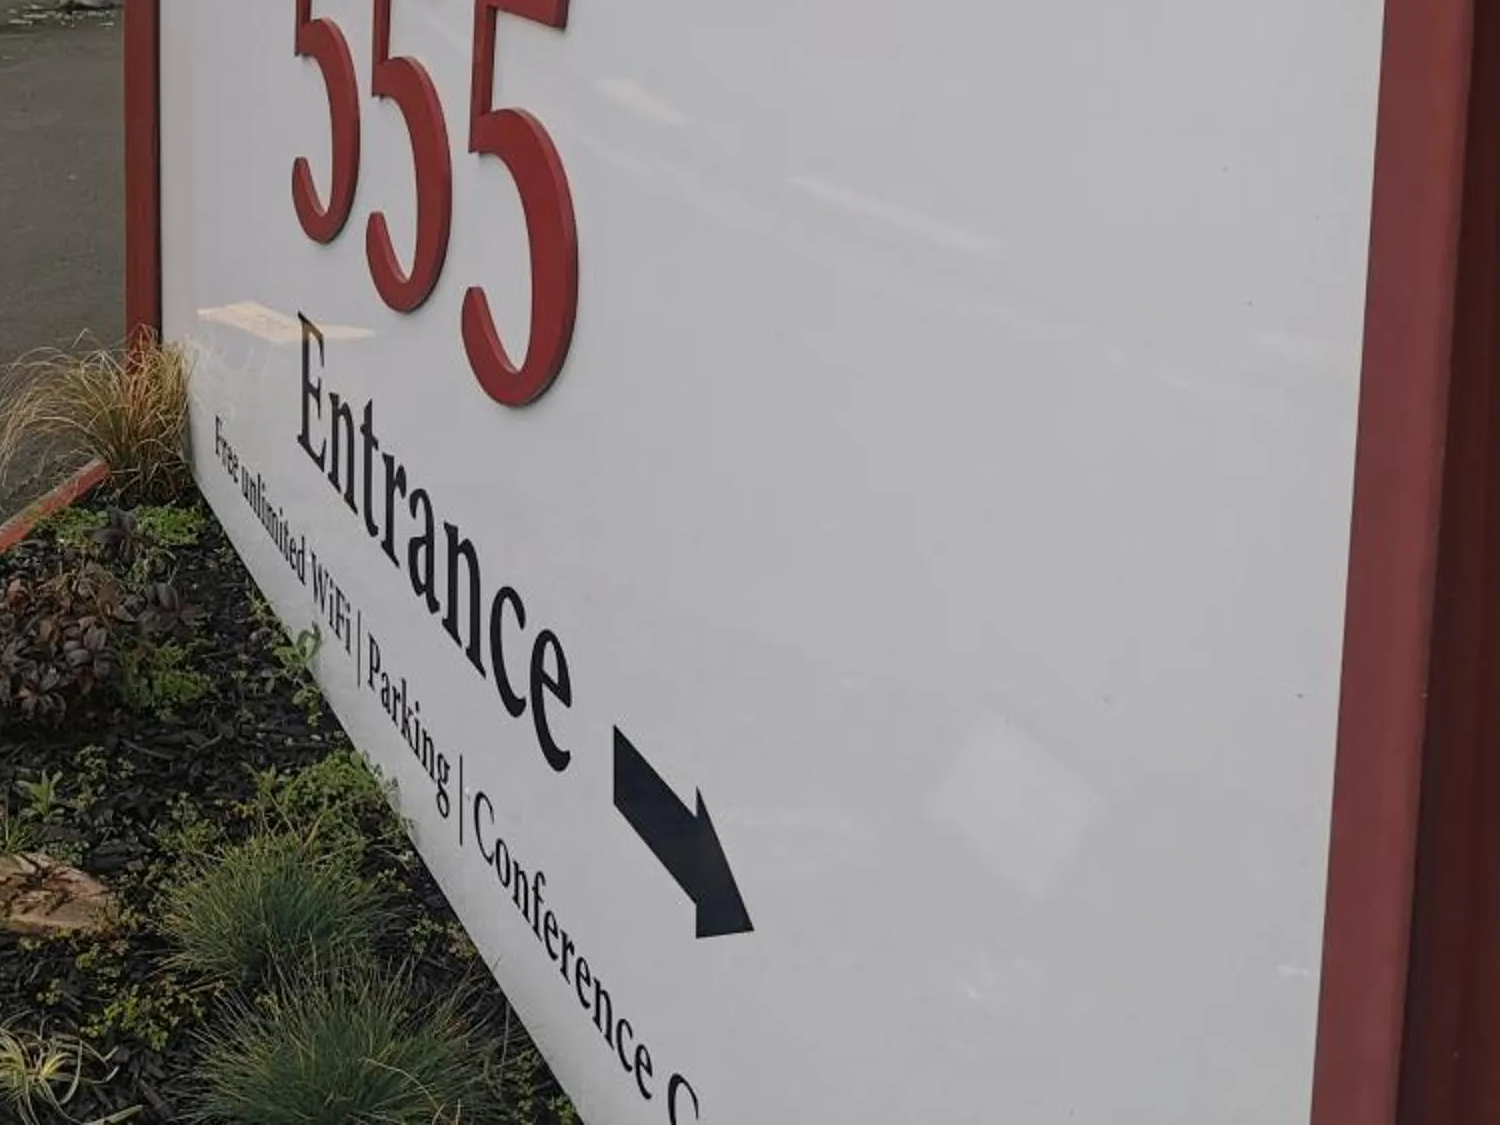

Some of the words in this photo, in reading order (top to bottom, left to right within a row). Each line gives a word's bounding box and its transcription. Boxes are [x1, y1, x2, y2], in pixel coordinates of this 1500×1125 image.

[214, 415, 239, 484] Free
[241, 473, 306, 586] unlimited
[311, 547, 351, 657] WiFi
[367, 631, 450, 819] Parking
[473, 790, 653, 1100] Conference
[298, 310, 572, 772] Entrance
